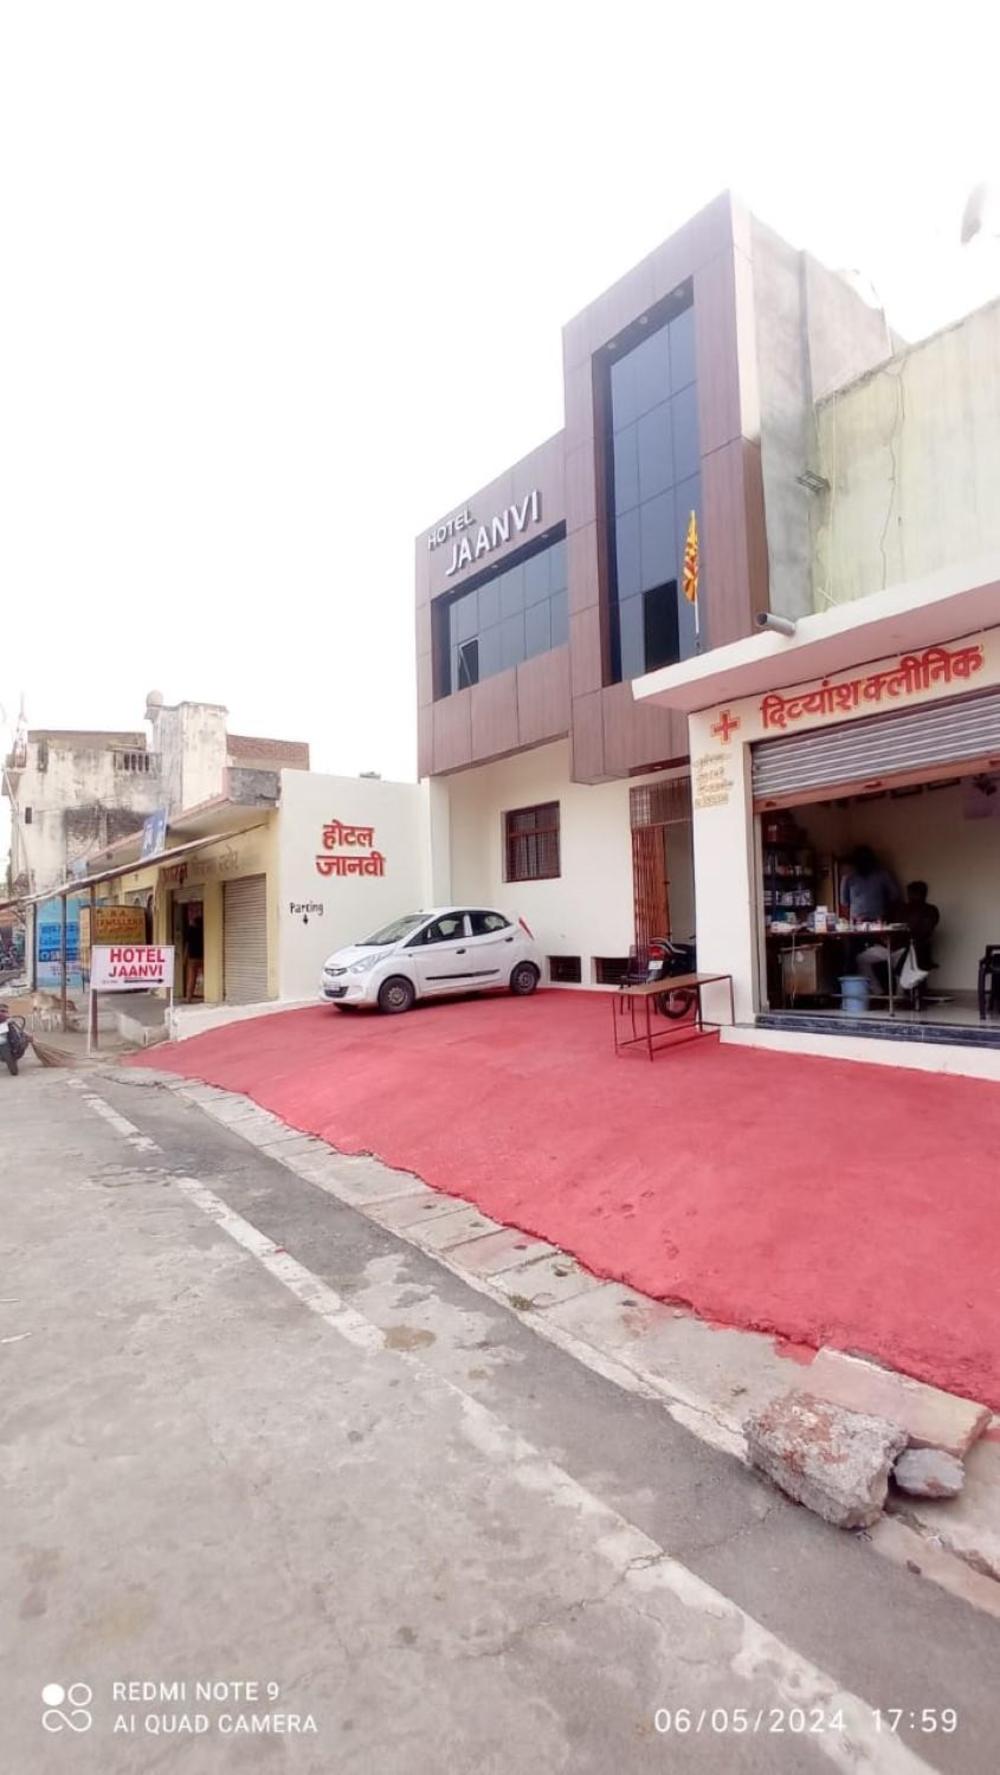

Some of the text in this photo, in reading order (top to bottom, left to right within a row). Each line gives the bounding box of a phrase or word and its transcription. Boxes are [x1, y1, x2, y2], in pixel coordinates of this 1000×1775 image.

[427, 508, 475, 550] HOTEL
[445, 490, 541, 576] JAANVI
[322, 819, 374, 849] होटल
[316, 851, 385, 876] जानवी
[110, 948, 165, 963] HOTEL
[108, 965, 163, 977] JAANVI
